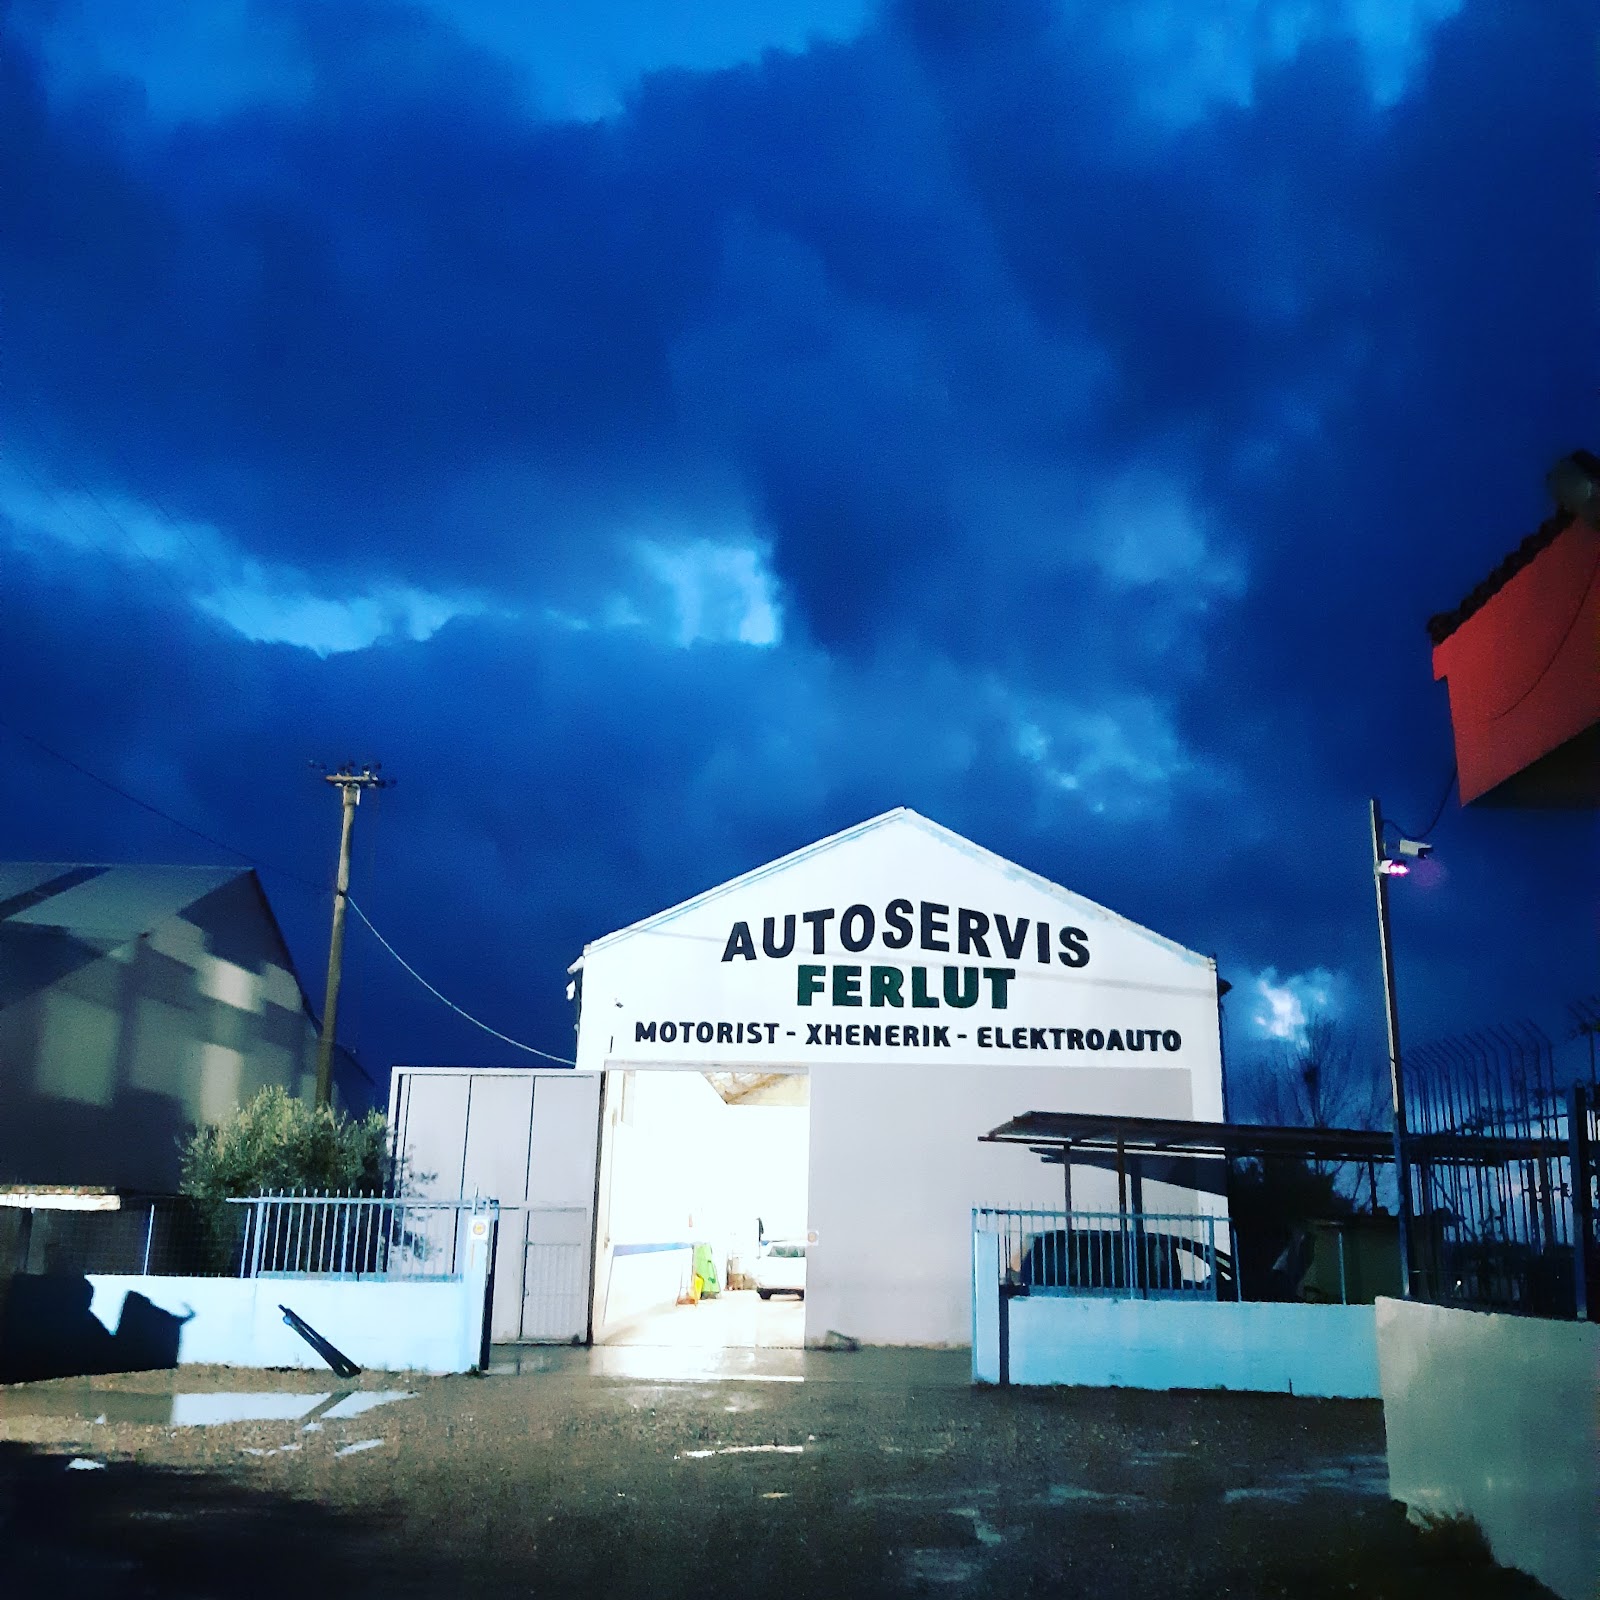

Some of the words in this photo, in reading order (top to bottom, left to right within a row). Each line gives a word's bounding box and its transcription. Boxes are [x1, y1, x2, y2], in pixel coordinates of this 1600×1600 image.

[722, 898, 1090, 969] AUTOSERVIS
[797, 964, 1016, 1010] FERLUT
[635, 1021, 780, 1045] MOTORIST
[806, 1023, 952, 1048] XHENERIK
[977, 1026, 1182, 1052] ELEKTROAUTO
